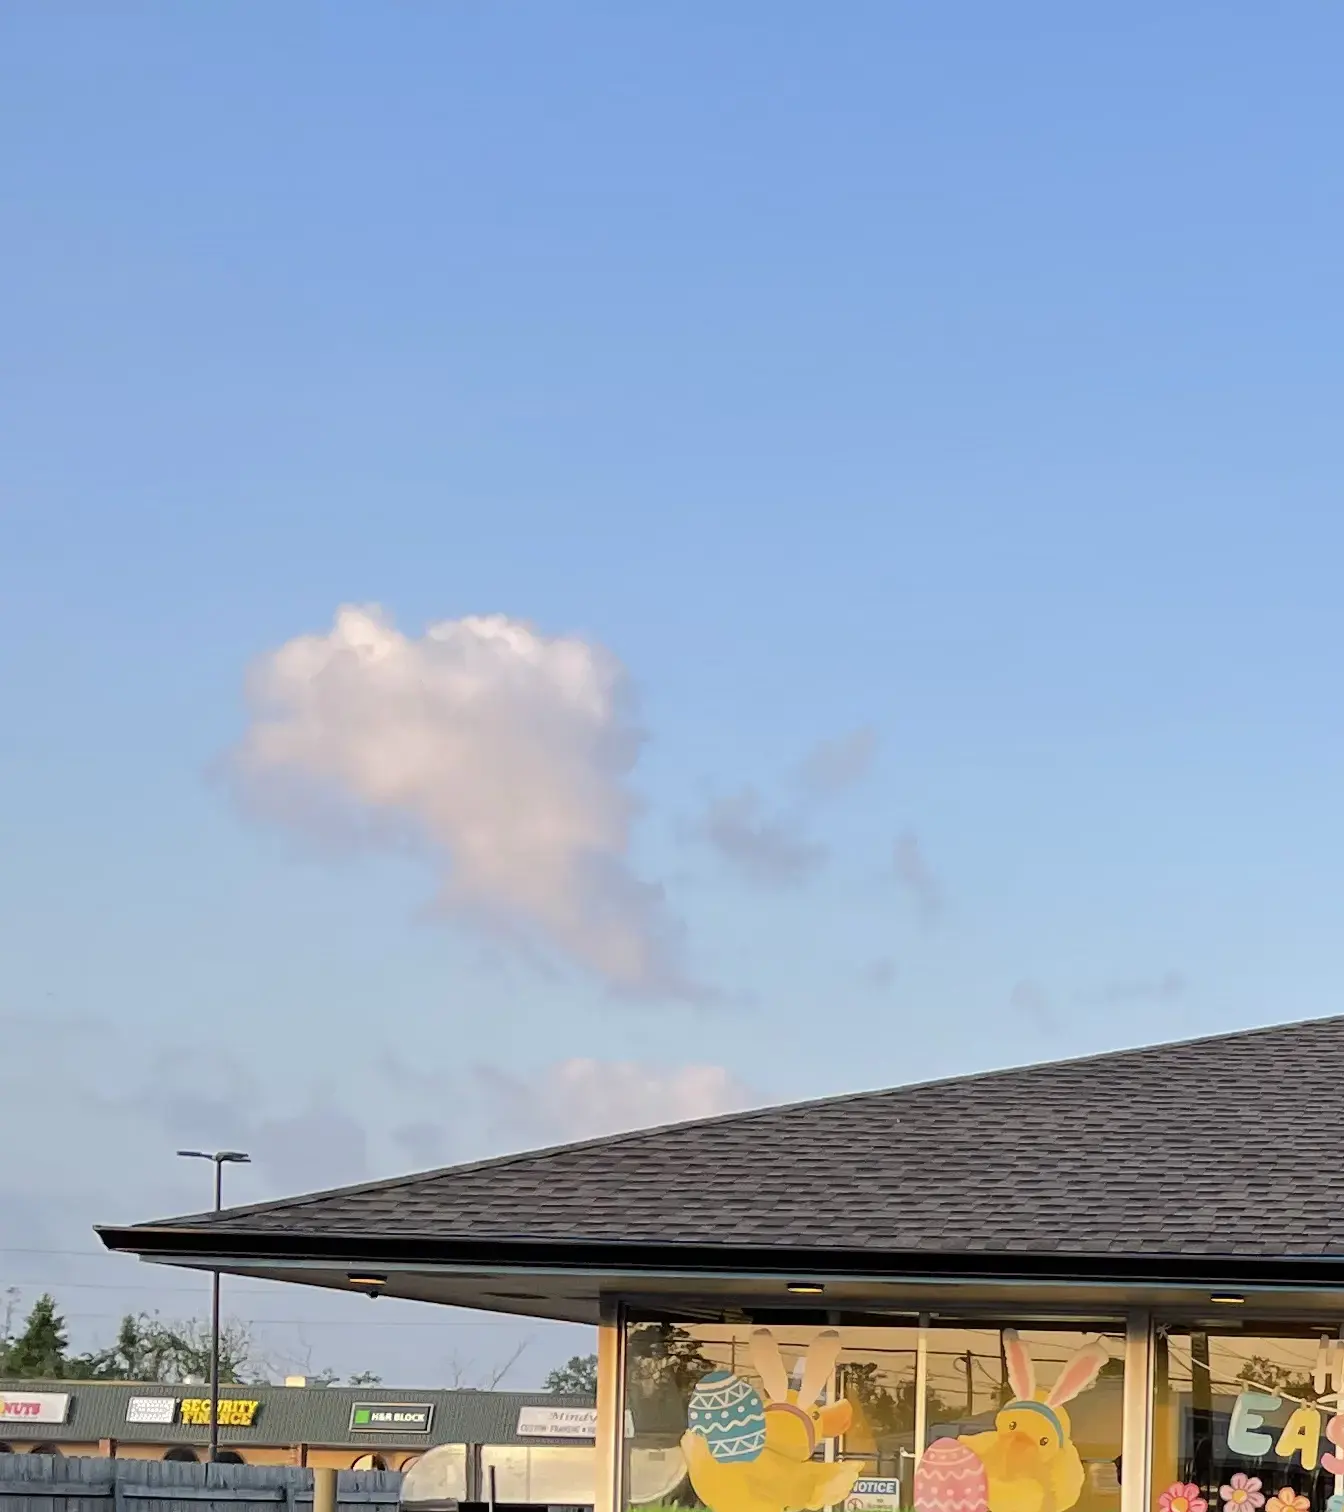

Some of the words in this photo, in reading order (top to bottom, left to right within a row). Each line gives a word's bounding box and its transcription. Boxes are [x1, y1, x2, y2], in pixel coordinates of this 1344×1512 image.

[0, 1400, 41, 1415] NUTS
[182, 1411, 252, 1426] FINNCE
[393, 1412, 426, 1422] BLOCK
